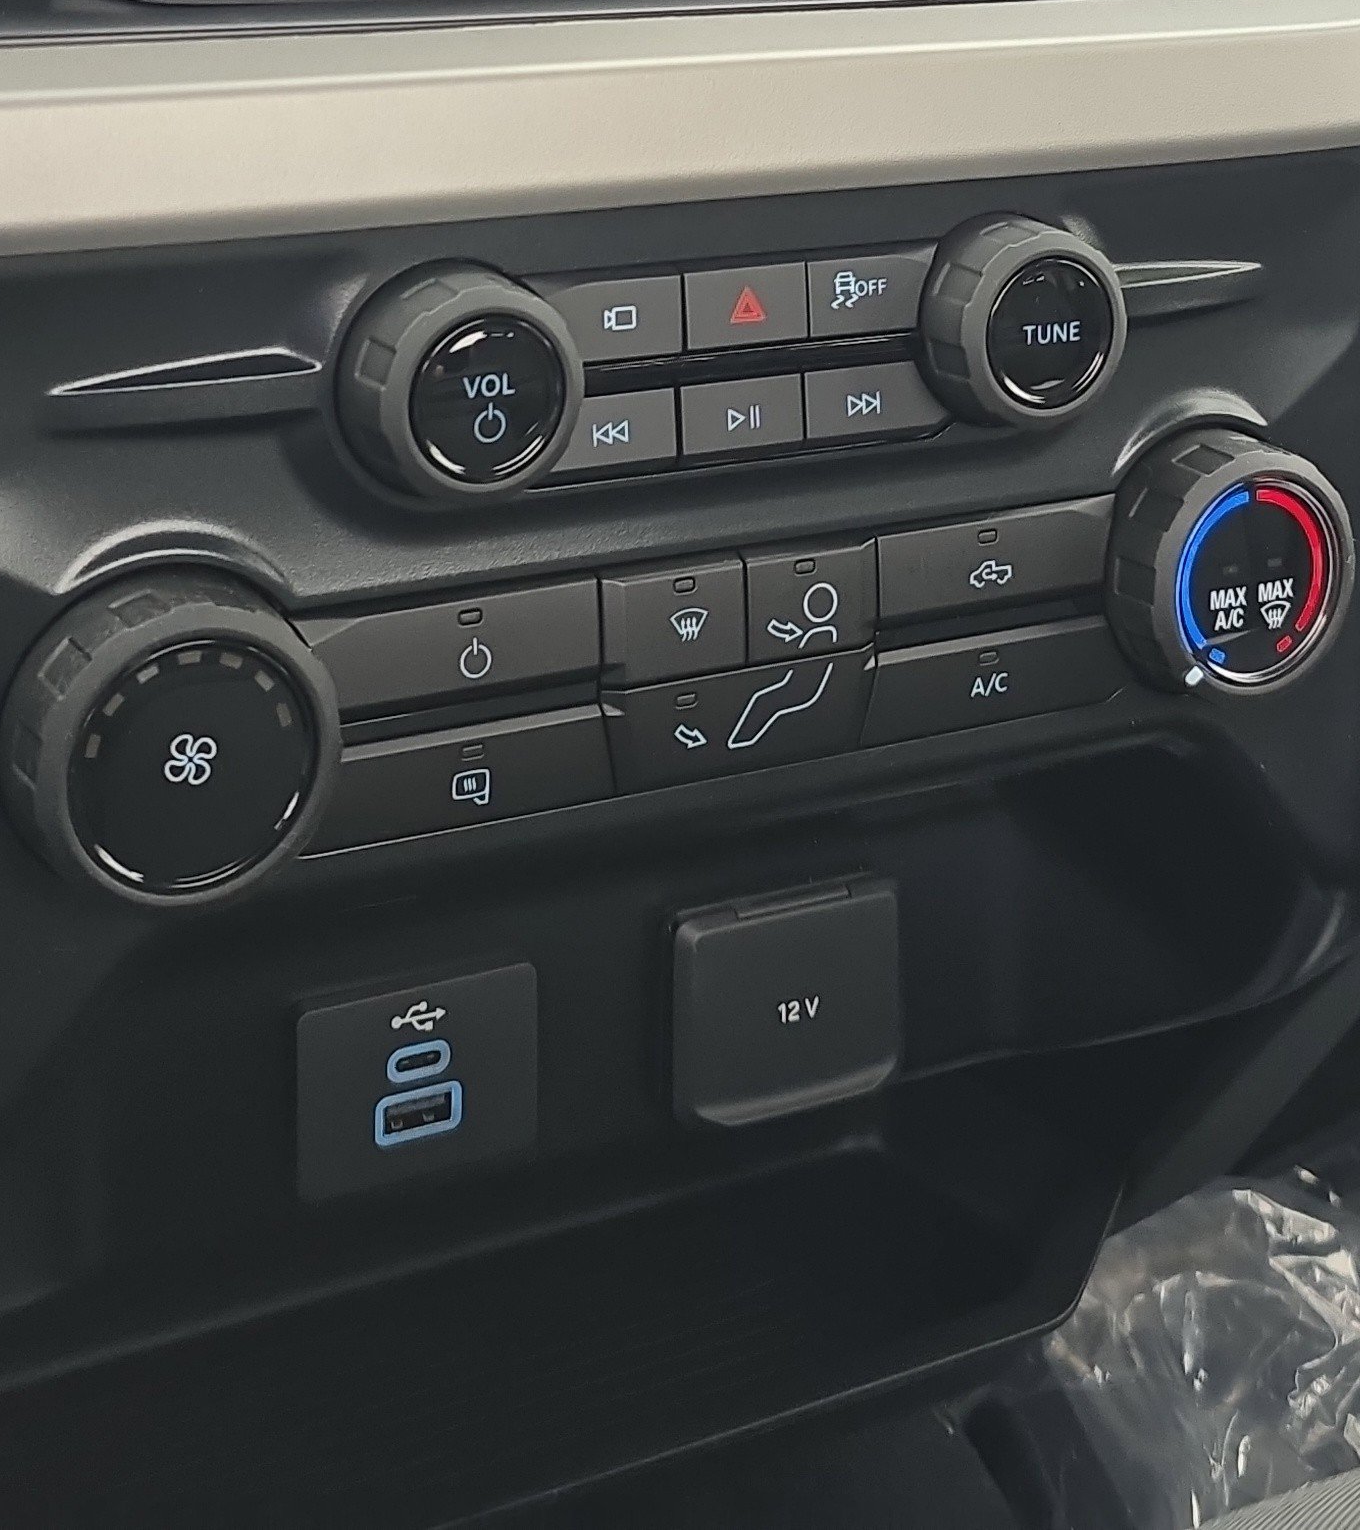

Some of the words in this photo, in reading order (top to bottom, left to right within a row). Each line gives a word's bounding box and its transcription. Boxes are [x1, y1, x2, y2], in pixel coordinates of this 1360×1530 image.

[855, 278, 887, 297] OFF
[1023, 321, 1081, 346] TUNE
[462, 372, 516, 399] VOL
[1209, 586, 1247, 610] MAX
[1257, 578, 1294, 603] MAX
[1213, 608, 1244, 631] A/C
[970, 672, 1008, 698] A/C
